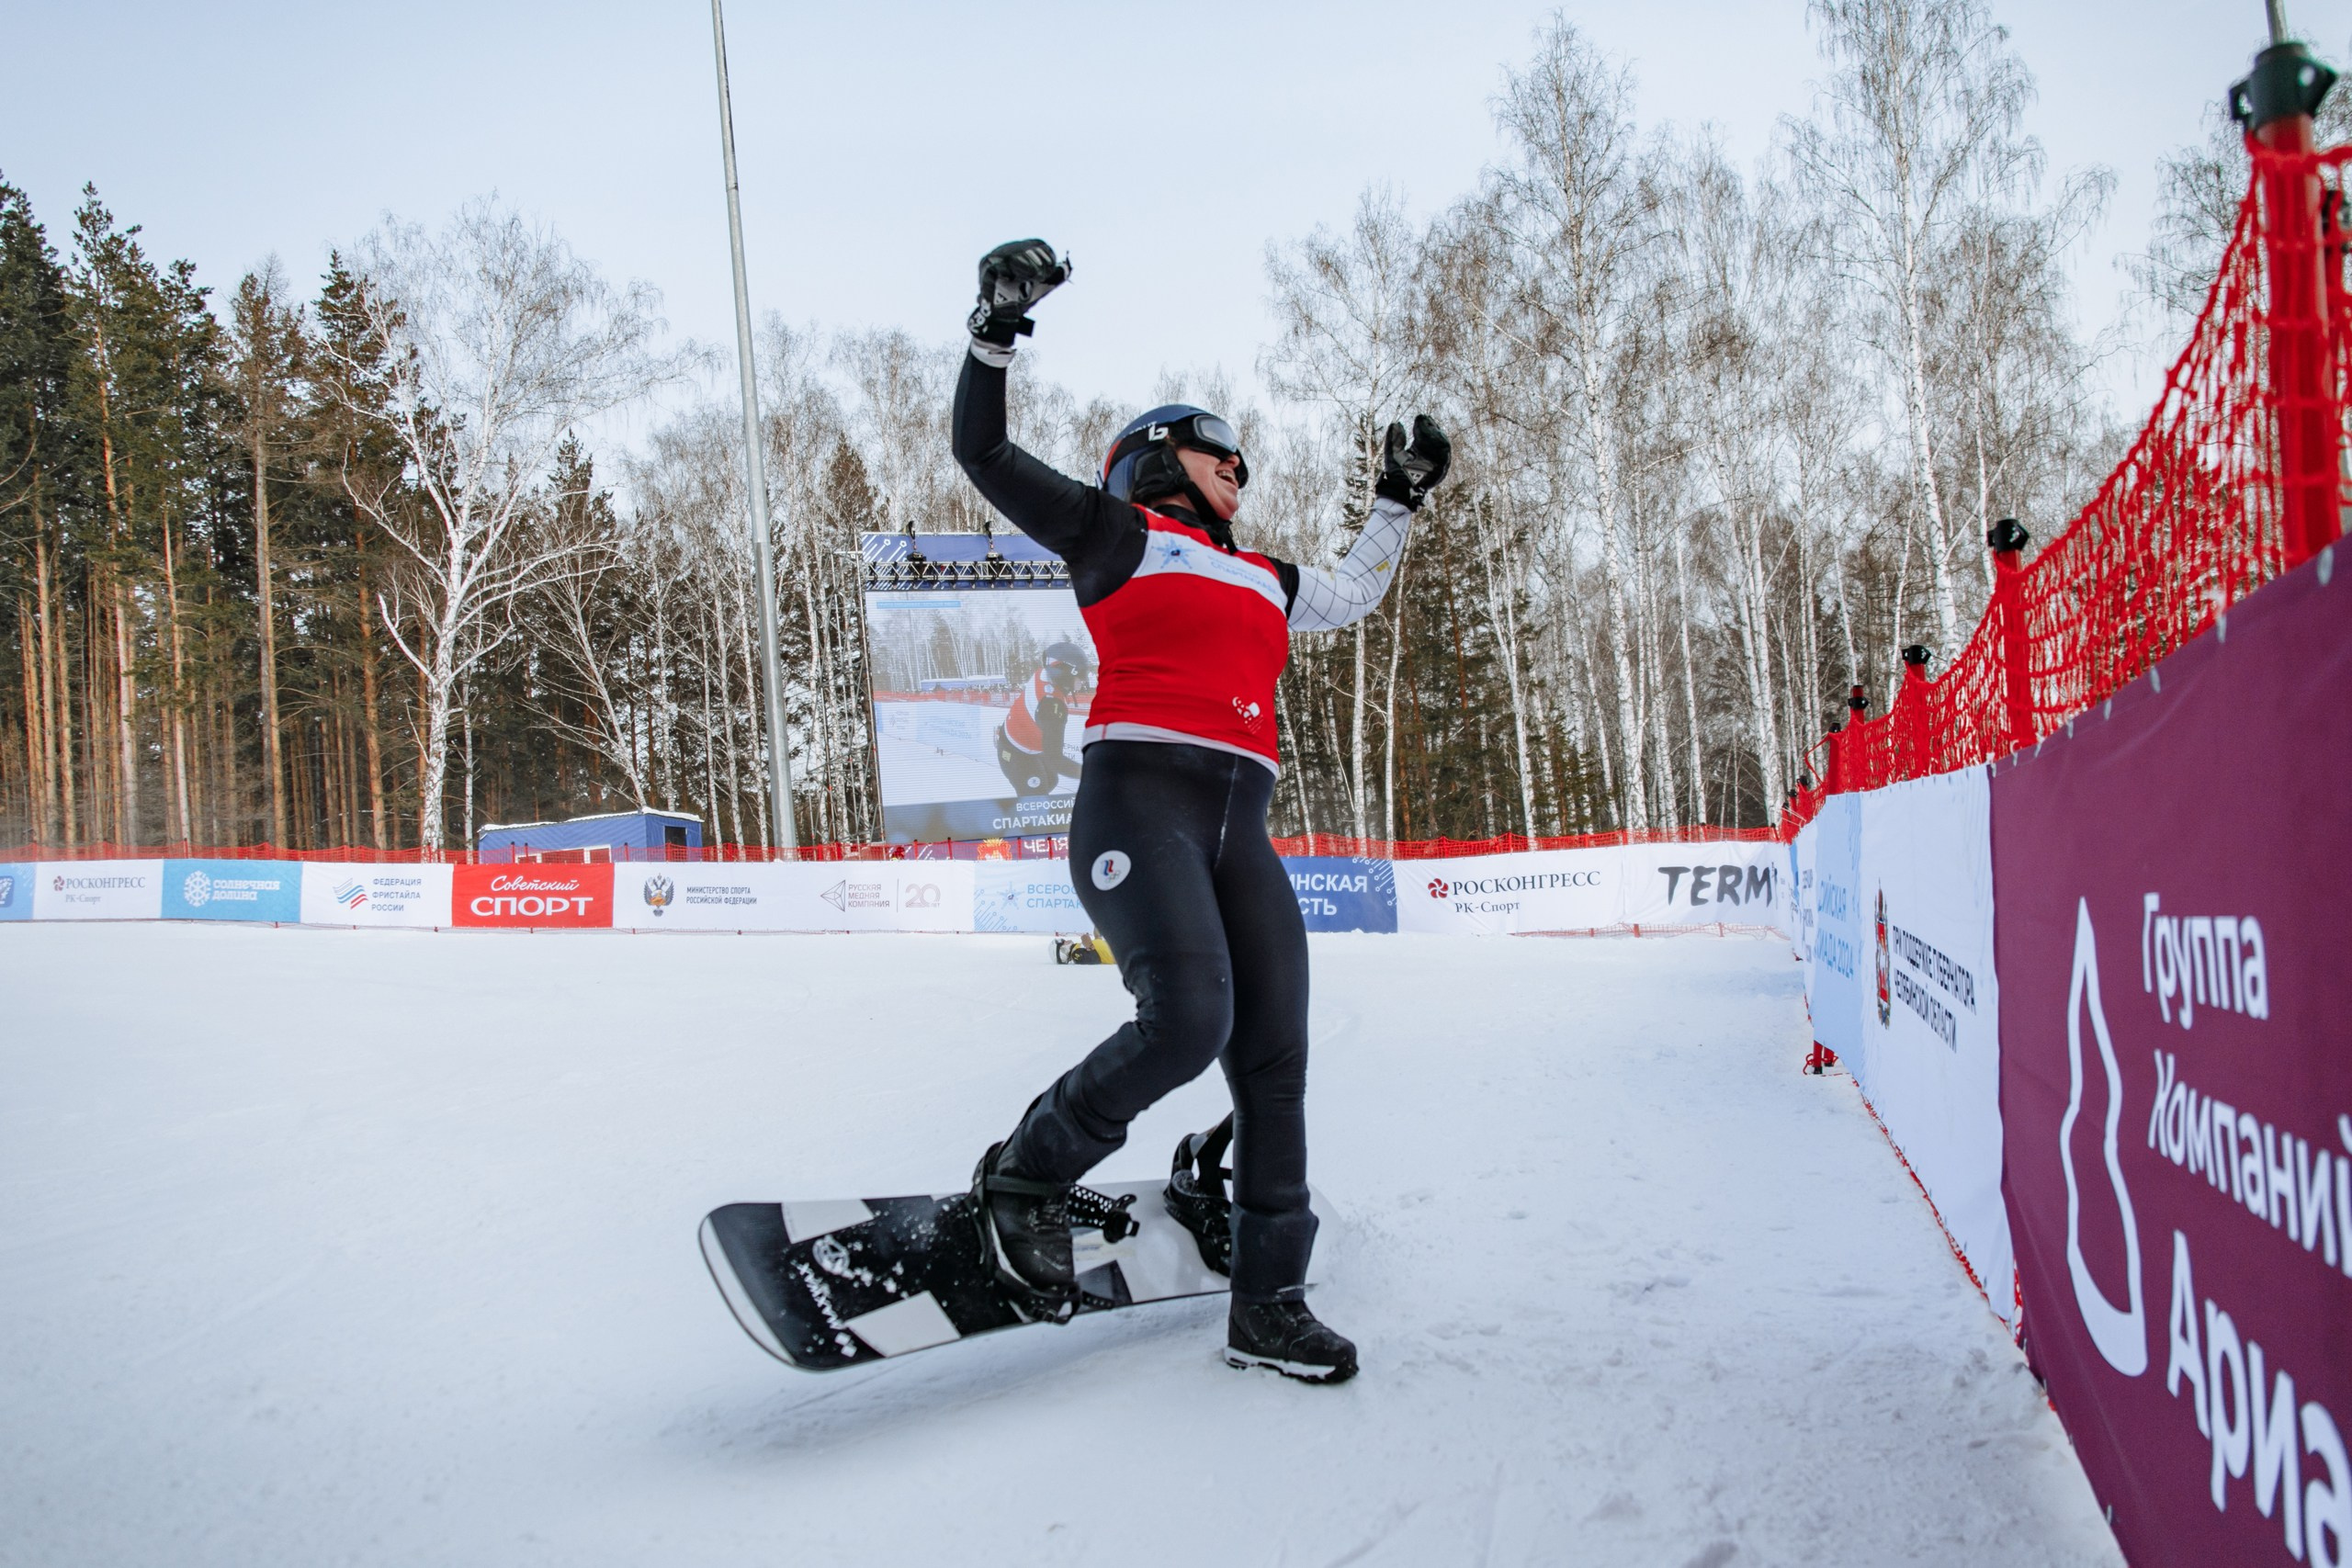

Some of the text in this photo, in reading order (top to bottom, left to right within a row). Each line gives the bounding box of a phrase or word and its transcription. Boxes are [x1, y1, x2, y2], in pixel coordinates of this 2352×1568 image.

[66, 876, 146, 889] РОСКОНГРЕСС
[372, 878, 422, 886] ФЕДЕРАЦИЯ
[491, 875, 580, 892] Советский
[1453, 871, 1601, 896] РОСКОНГРЕСС
[1657, 863, 1775, 908] TERM
[371, 890, 422, 899] ФРИСТАЙЛА
[686, 886, 752, 895] МИНИСТЕРСТВО СПОРТА
[470, 897, 594, 917] СПОРТ
[686, 895, 758, 905] РОССИЙСКОЙ ФЕДЕРАЦИИ
[1455, 901, 1520, 914] РК-Спорт
[2142, 891, 2269, 1031] Группа
[2166, 1229, 2352, 1568] Ариа
